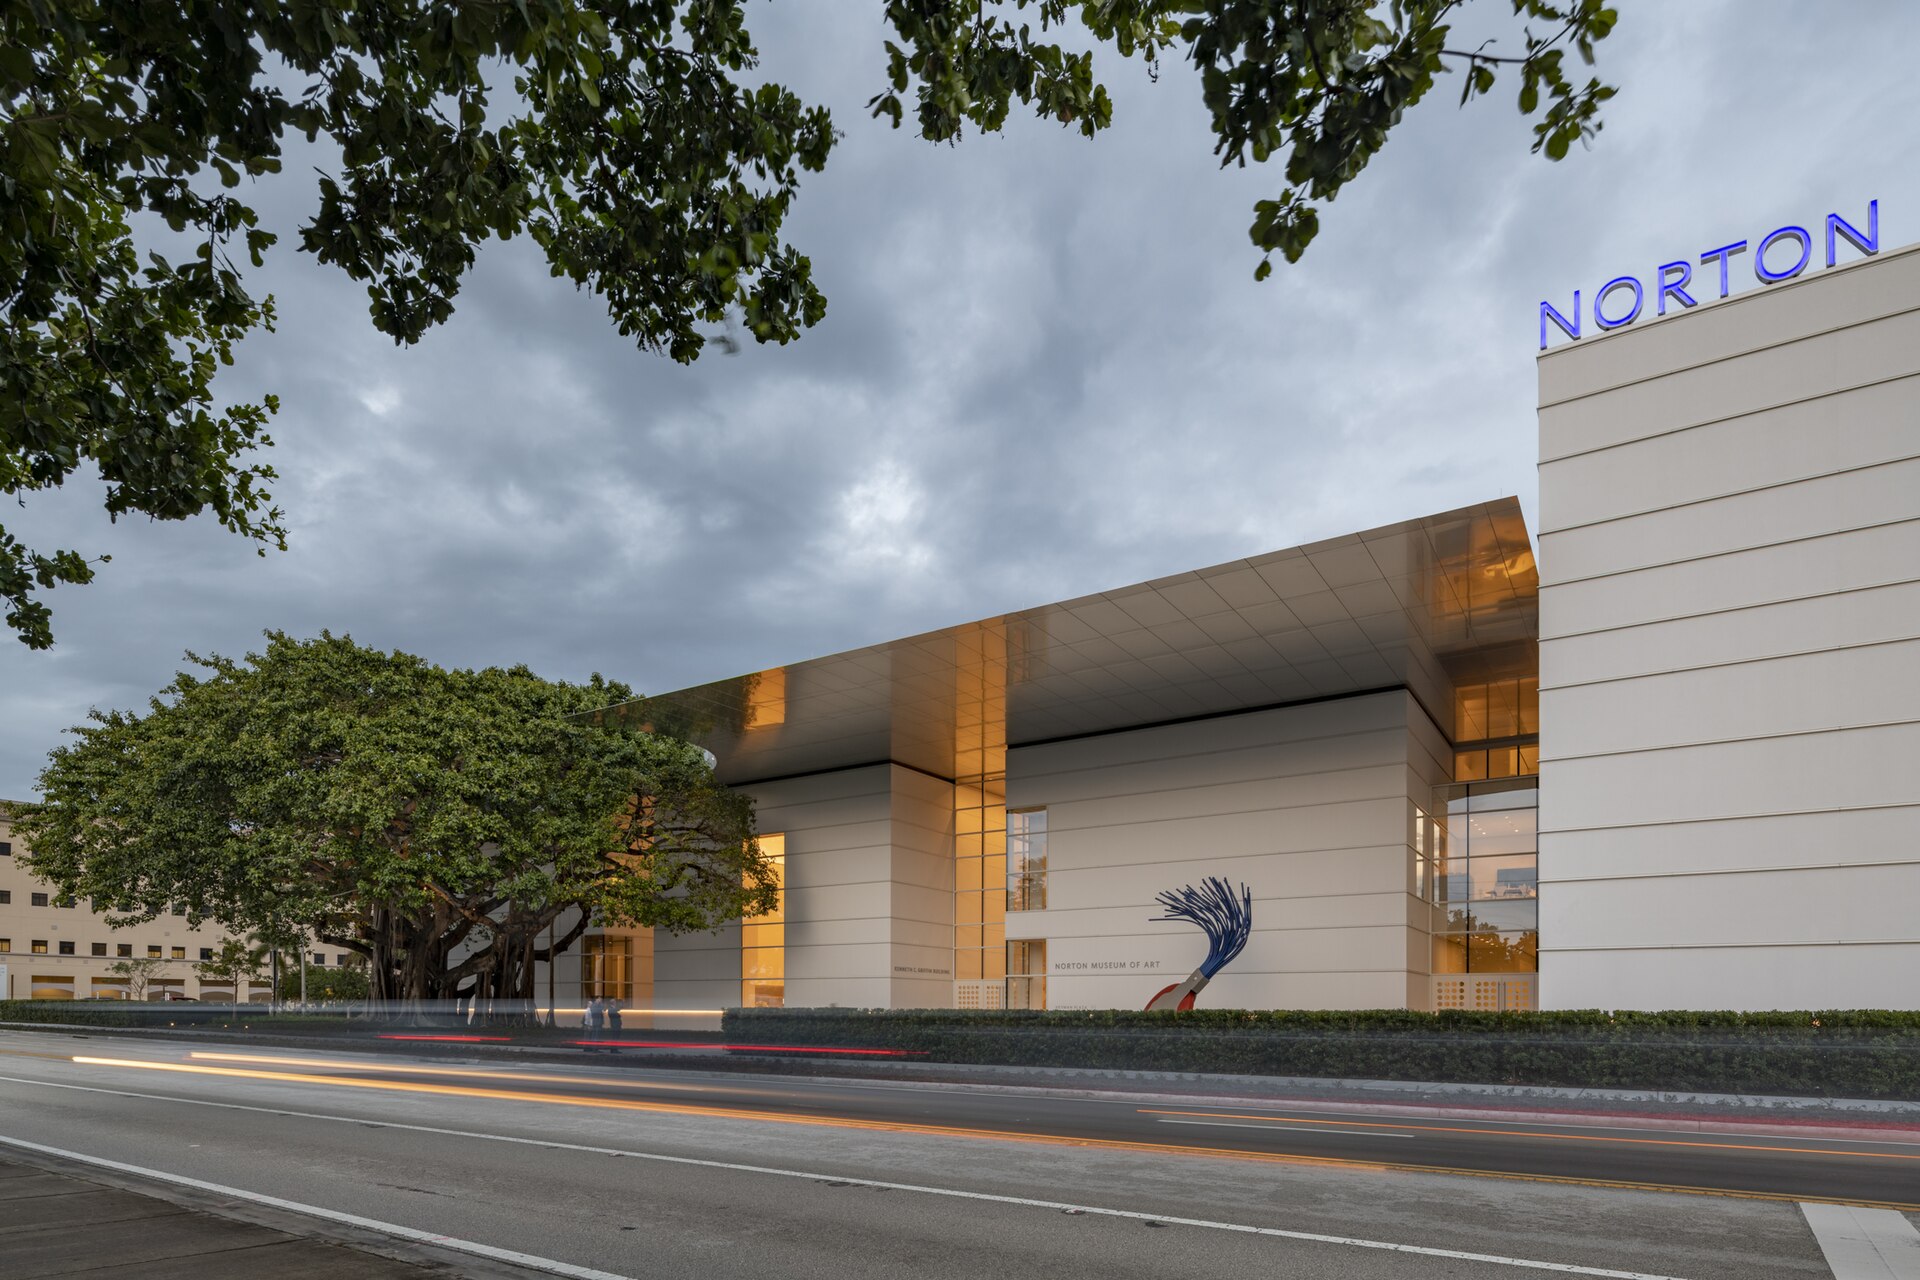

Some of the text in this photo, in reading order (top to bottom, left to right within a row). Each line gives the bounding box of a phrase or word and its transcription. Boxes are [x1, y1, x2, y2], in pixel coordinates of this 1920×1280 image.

[1540, 199, 1879, 351] NORTON
[1055, 962, 1088, 970] NORTON
[1129, 961, 1140, 969] OF
[1144, 961, 1161, 969] ART
